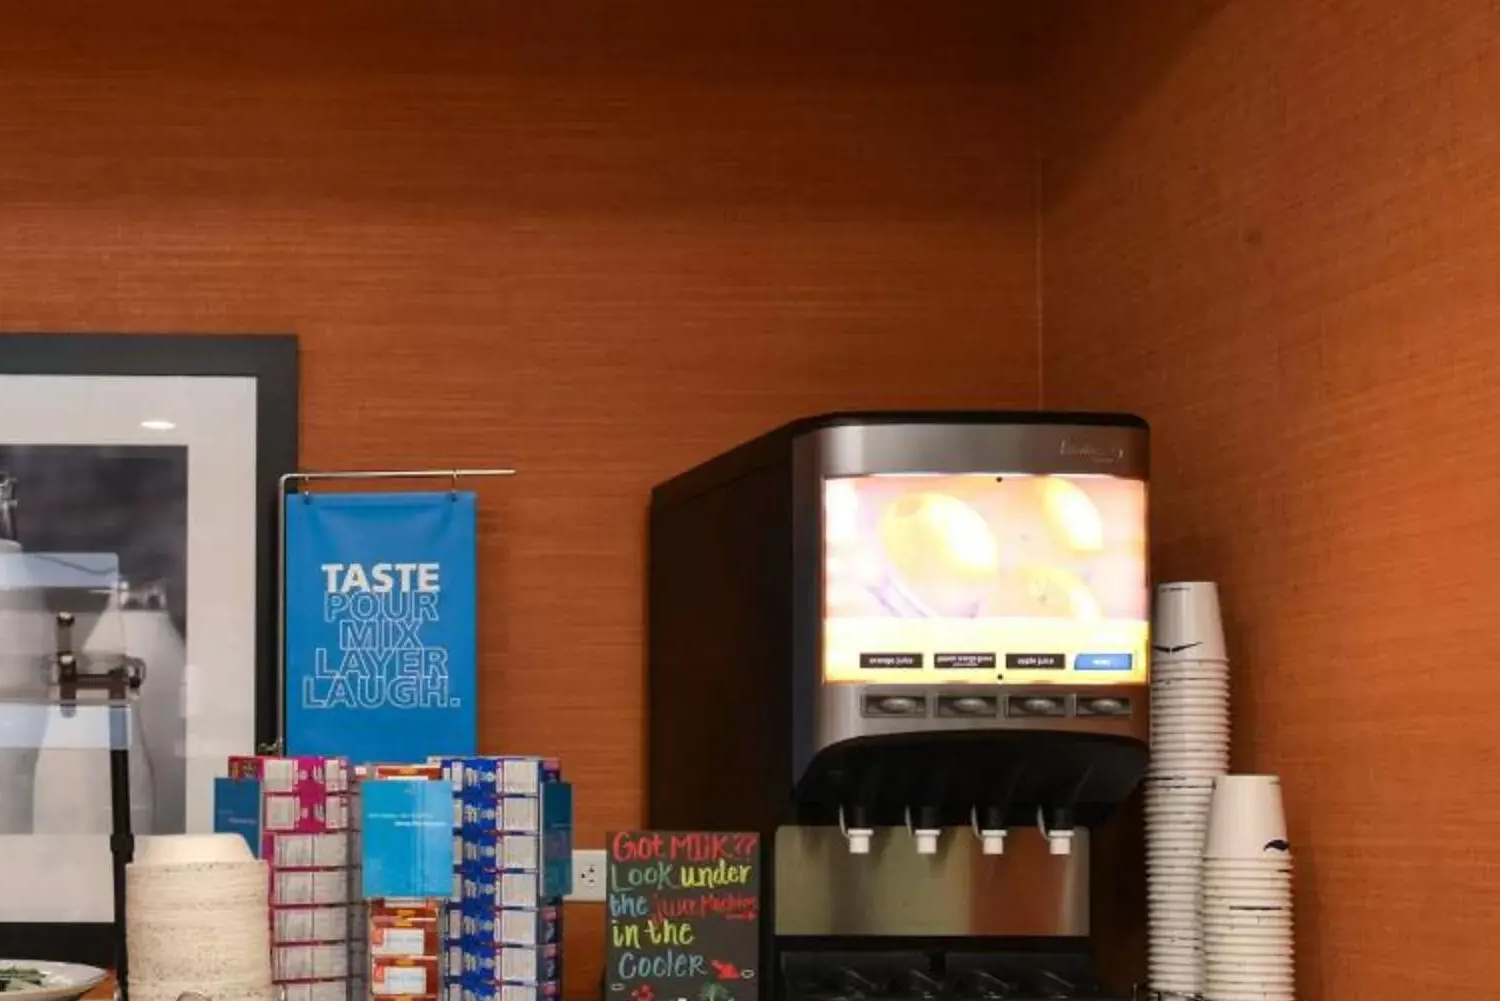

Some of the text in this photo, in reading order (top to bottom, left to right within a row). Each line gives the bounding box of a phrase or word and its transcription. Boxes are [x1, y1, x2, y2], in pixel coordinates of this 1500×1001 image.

[321, 563, 441, 593] TASTE
[323, 590, 440, 622] POUR
[339, 619, 424, 650] MIX
[315, 647, 449, 679] LAYER
[302, 676, 462, 709] LAUGH.
[612, 832, 665, 862] Got
[611, 859, 753, 893] Look under
[609, 893, 649, 917] the
[611, 919, 696, 949] in the
